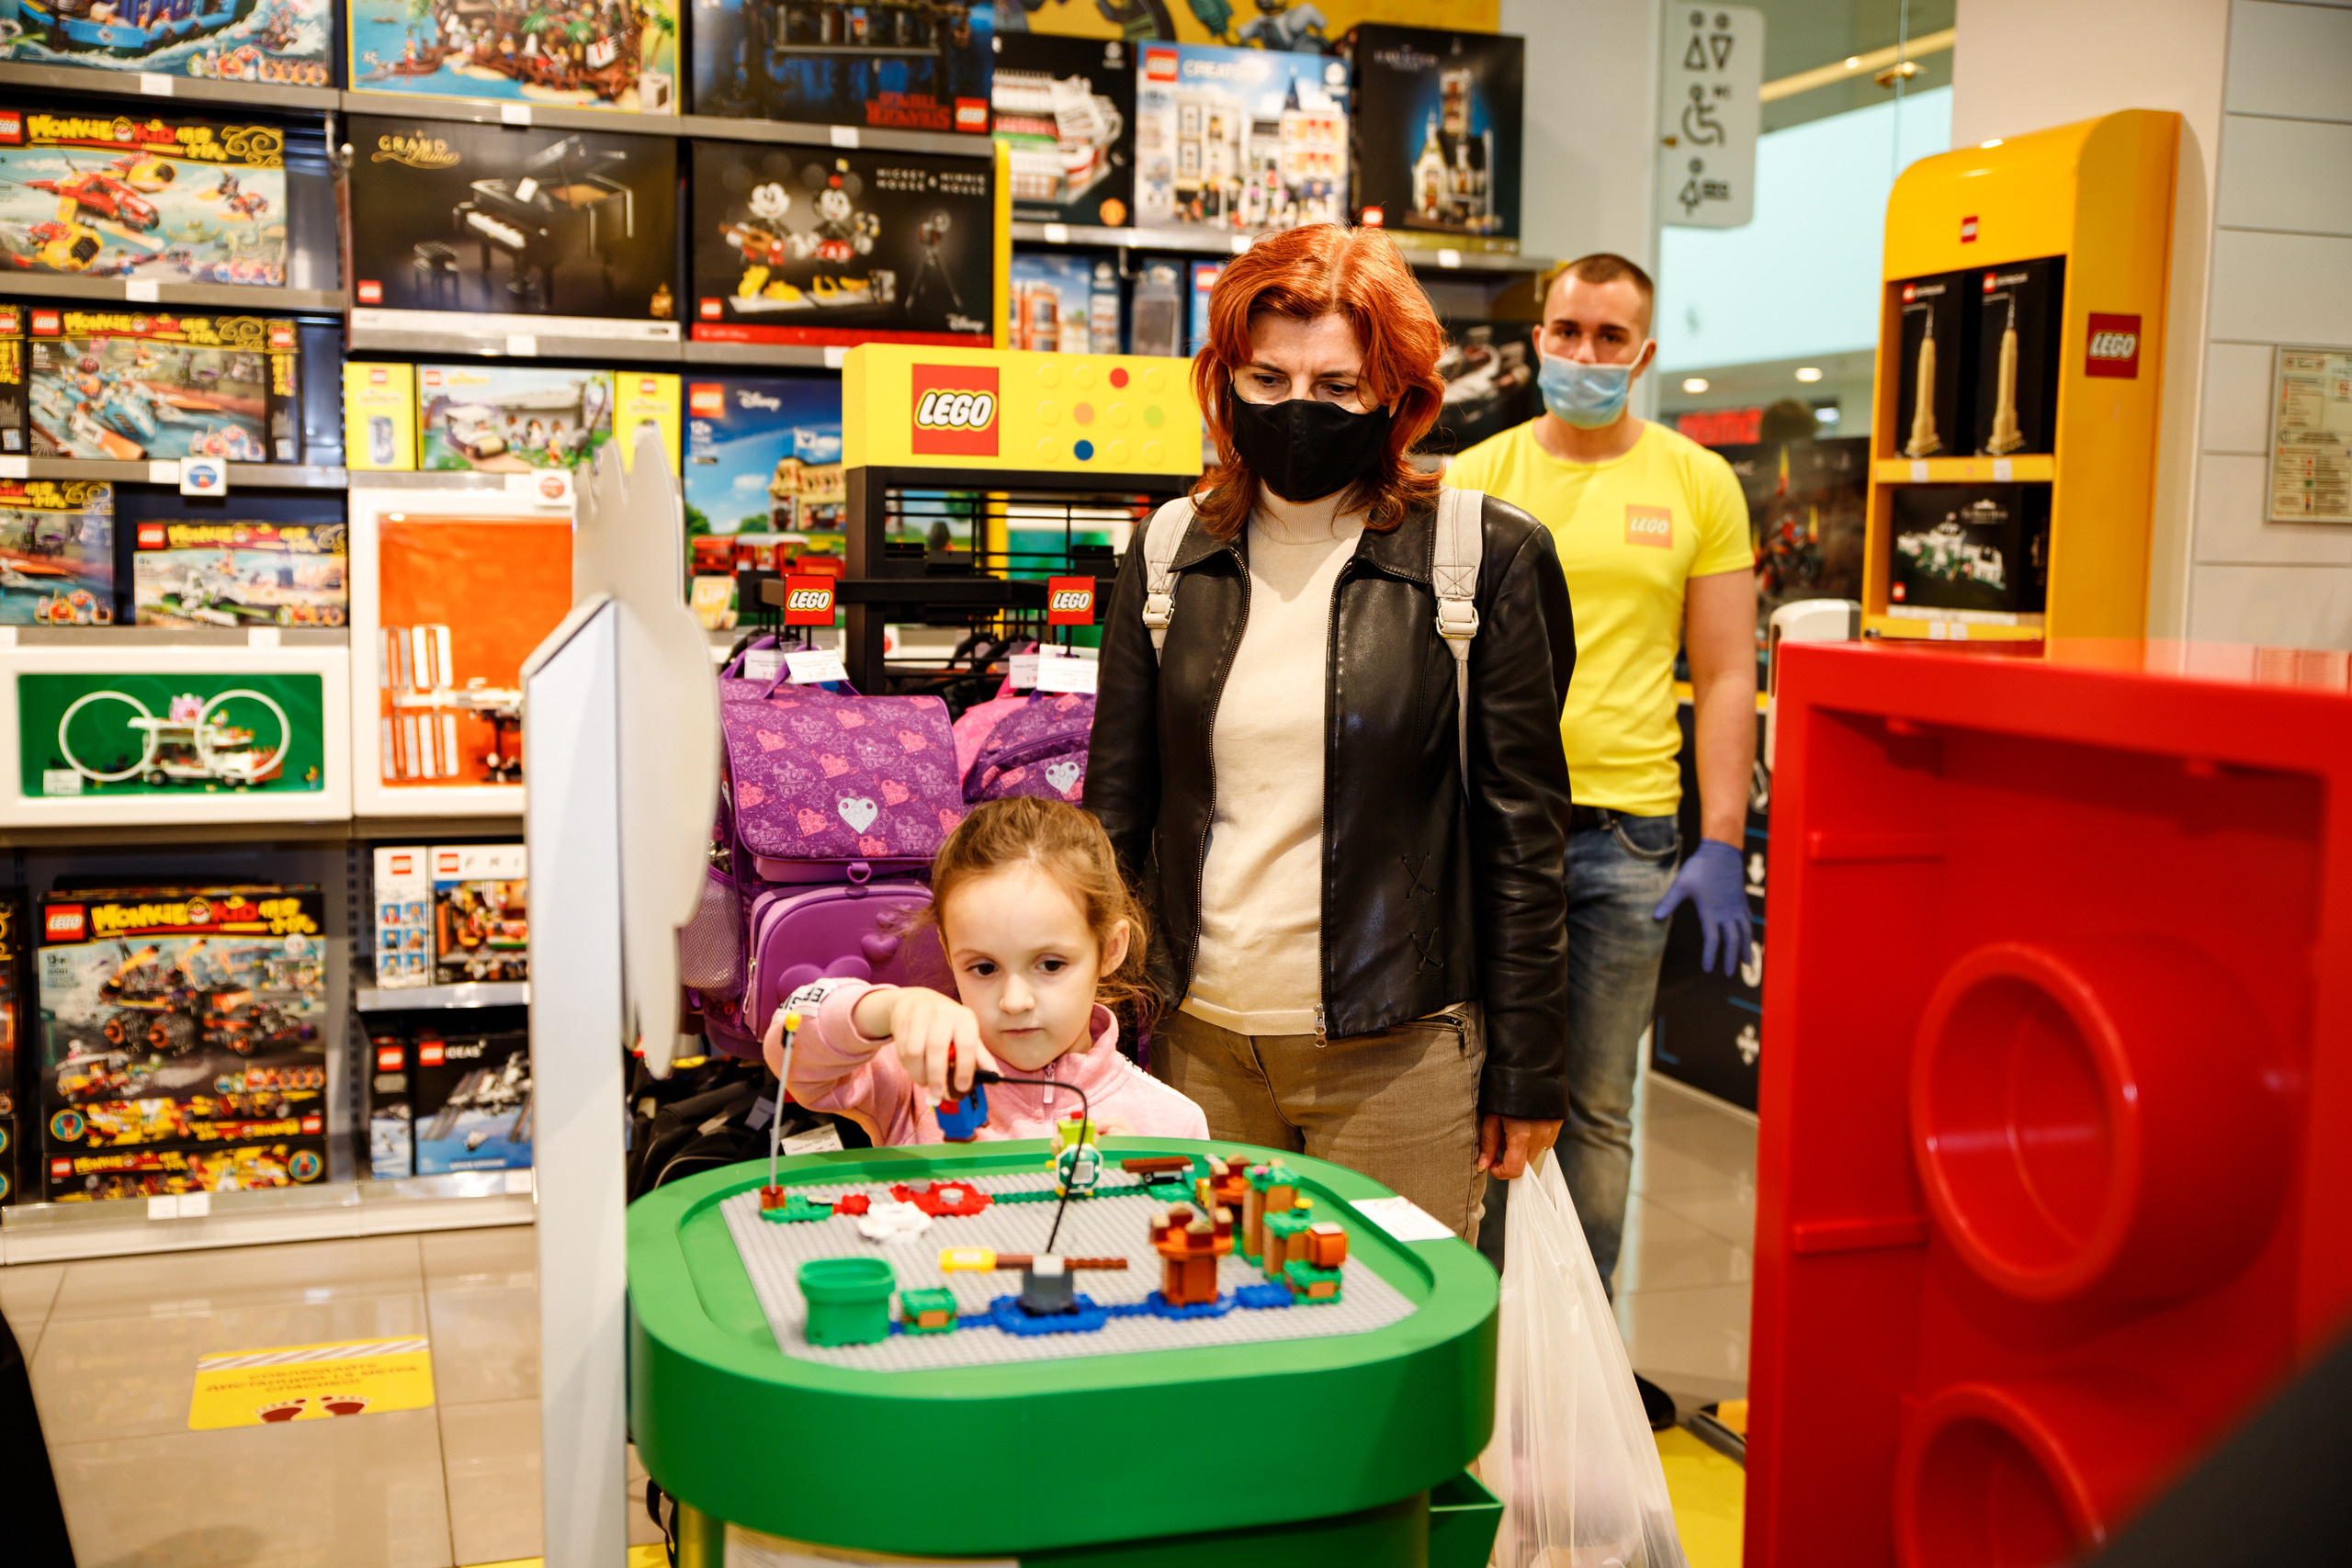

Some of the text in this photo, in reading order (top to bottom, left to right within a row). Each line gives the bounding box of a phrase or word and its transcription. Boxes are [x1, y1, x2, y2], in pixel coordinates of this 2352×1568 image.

[378, 134, 448, 155] GRAND
[876, 167, 926, 181] MICKEY
[2088, 332, 2137, 357] LEGO
[736, 389, 781, 412] Disney
[917, 391, 994, 428] LEGO
[1629, 516, 1669, 535] LEGO
[789, 591, 831, 609] LEGO
[1052, 592, 1091, 610] LEGO
[49, 914, 83, 931] LEGO
[92, 903, 188, 931] MONKIE
[446, 1044, 481, 1059] IDEAS
